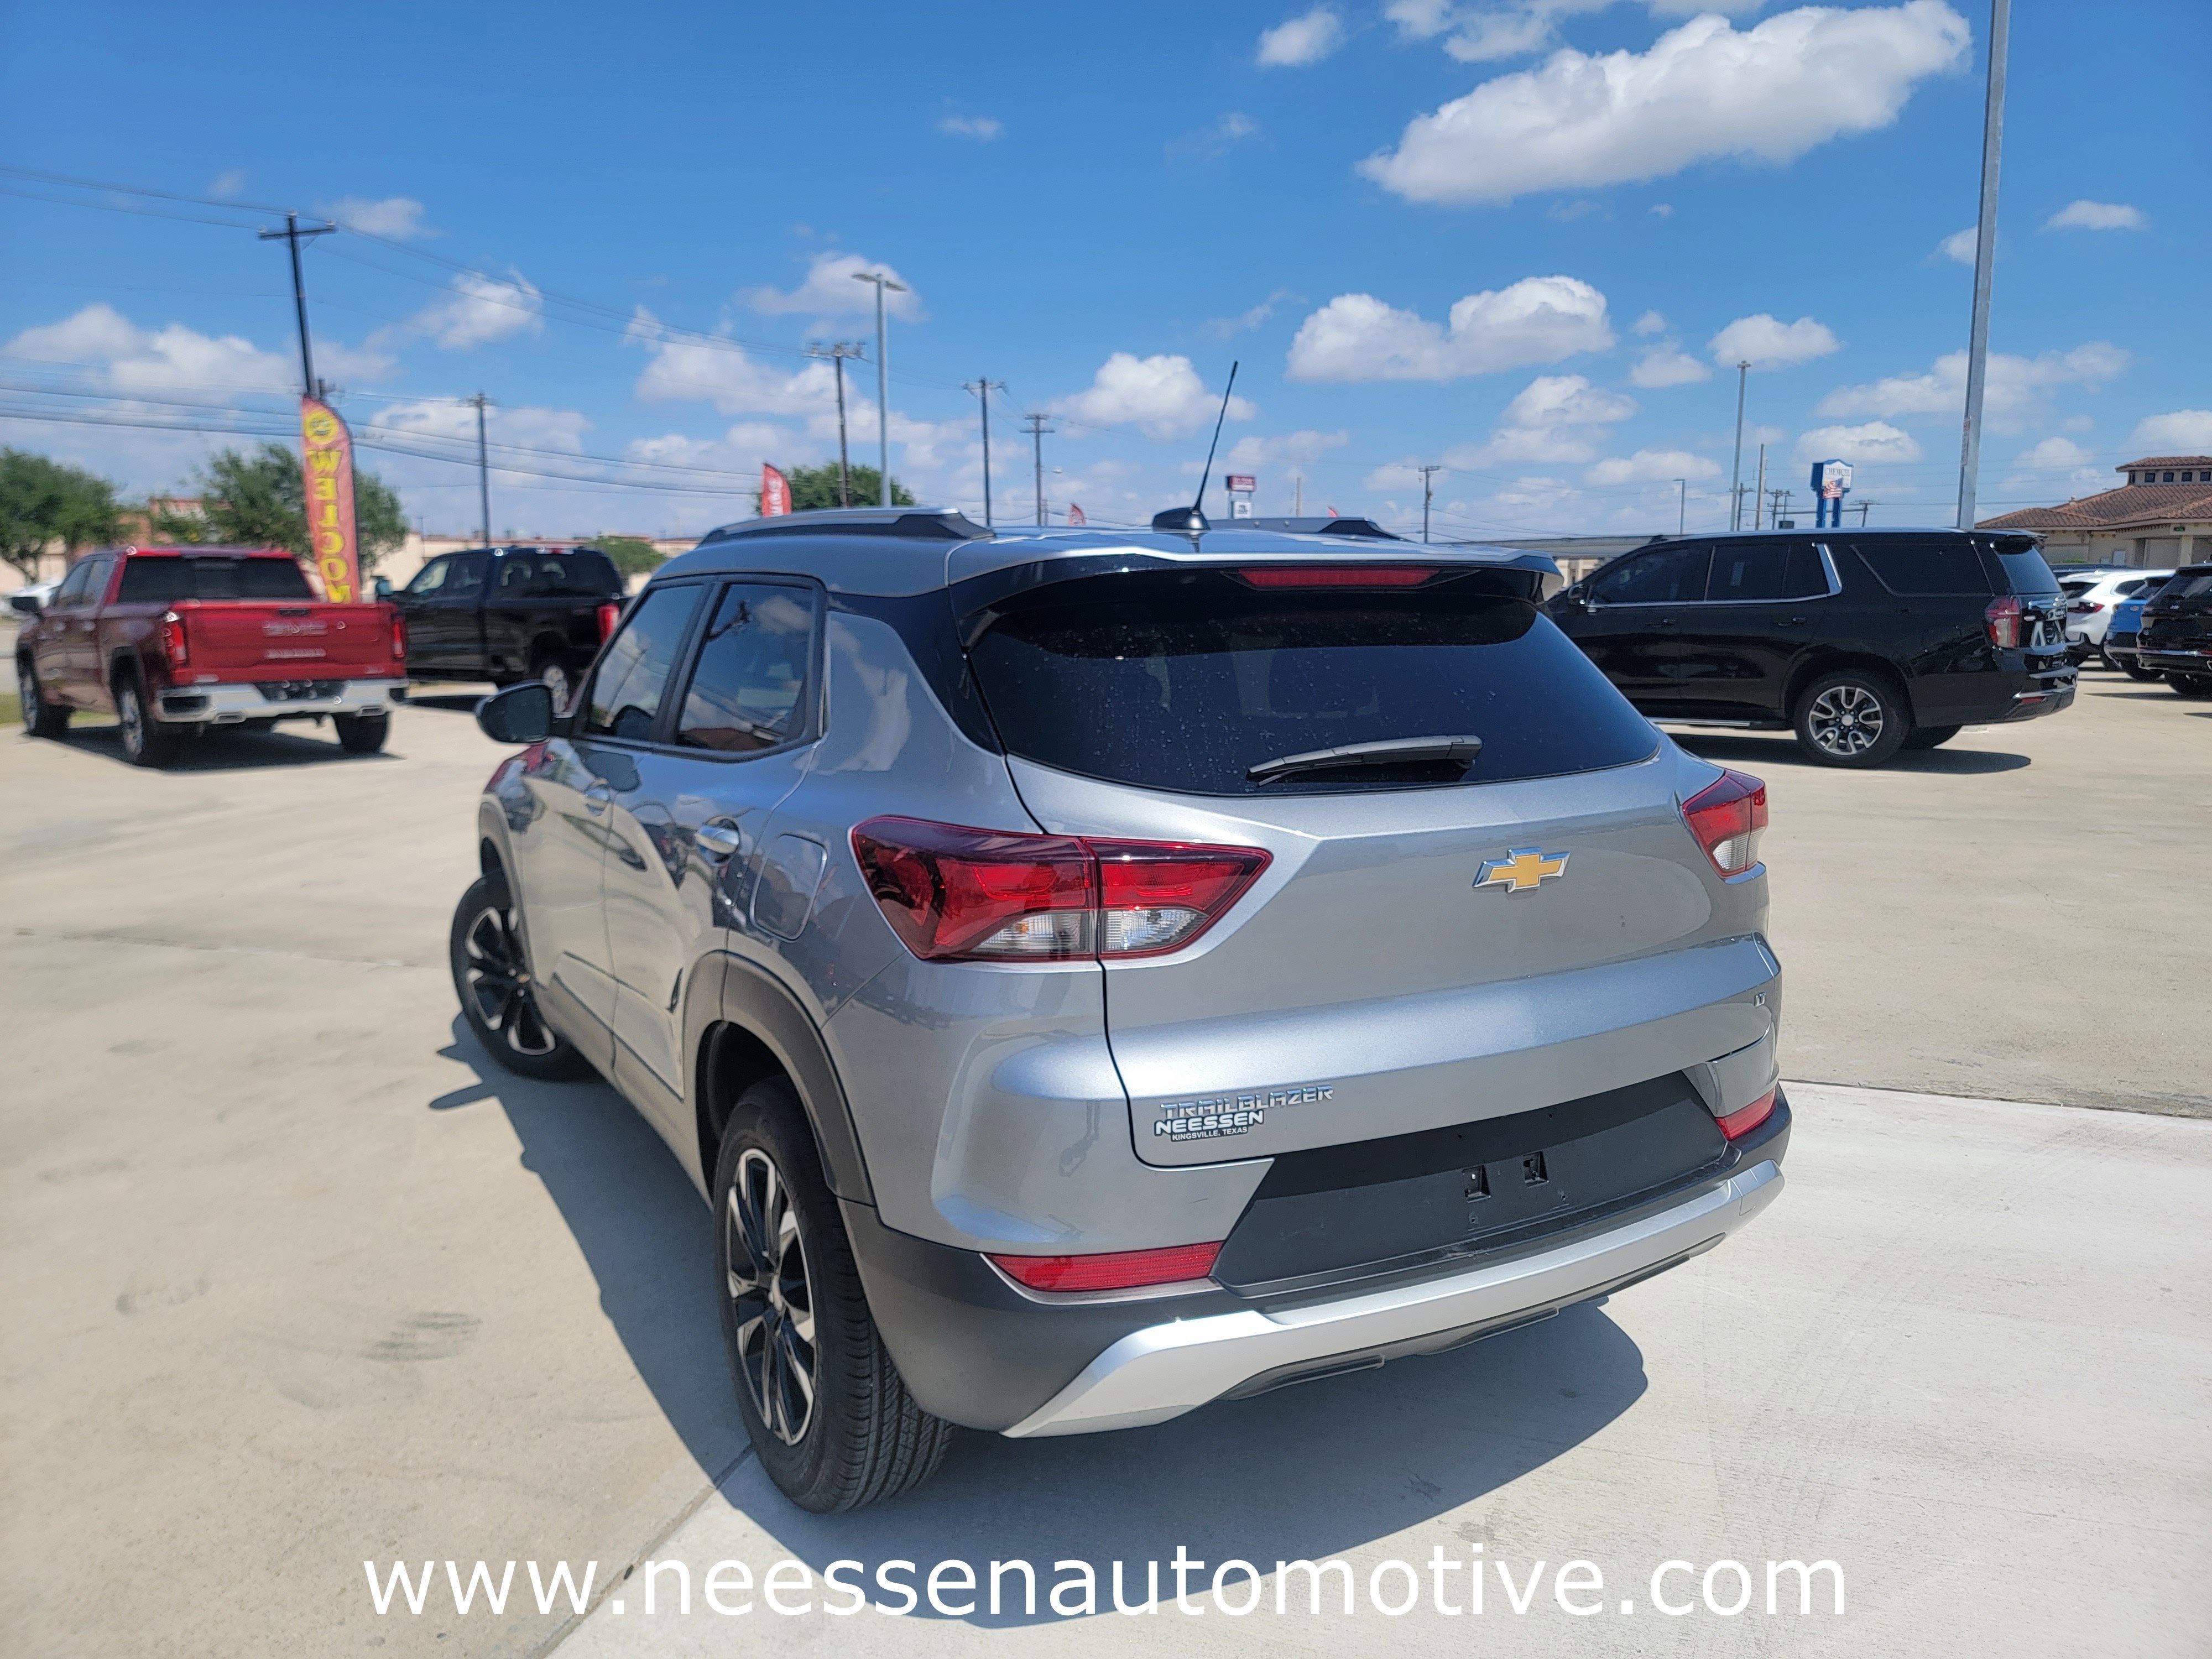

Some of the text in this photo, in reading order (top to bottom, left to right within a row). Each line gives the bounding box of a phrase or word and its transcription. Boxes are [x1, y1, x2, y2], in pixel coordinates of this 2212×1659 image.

[1161, 1085, 1333, 1119] TRAILBLAZER
[1155, 1110, 1264, 1135] NEESSEN
[1222, 1126, 1248, 1135] TEXAS
